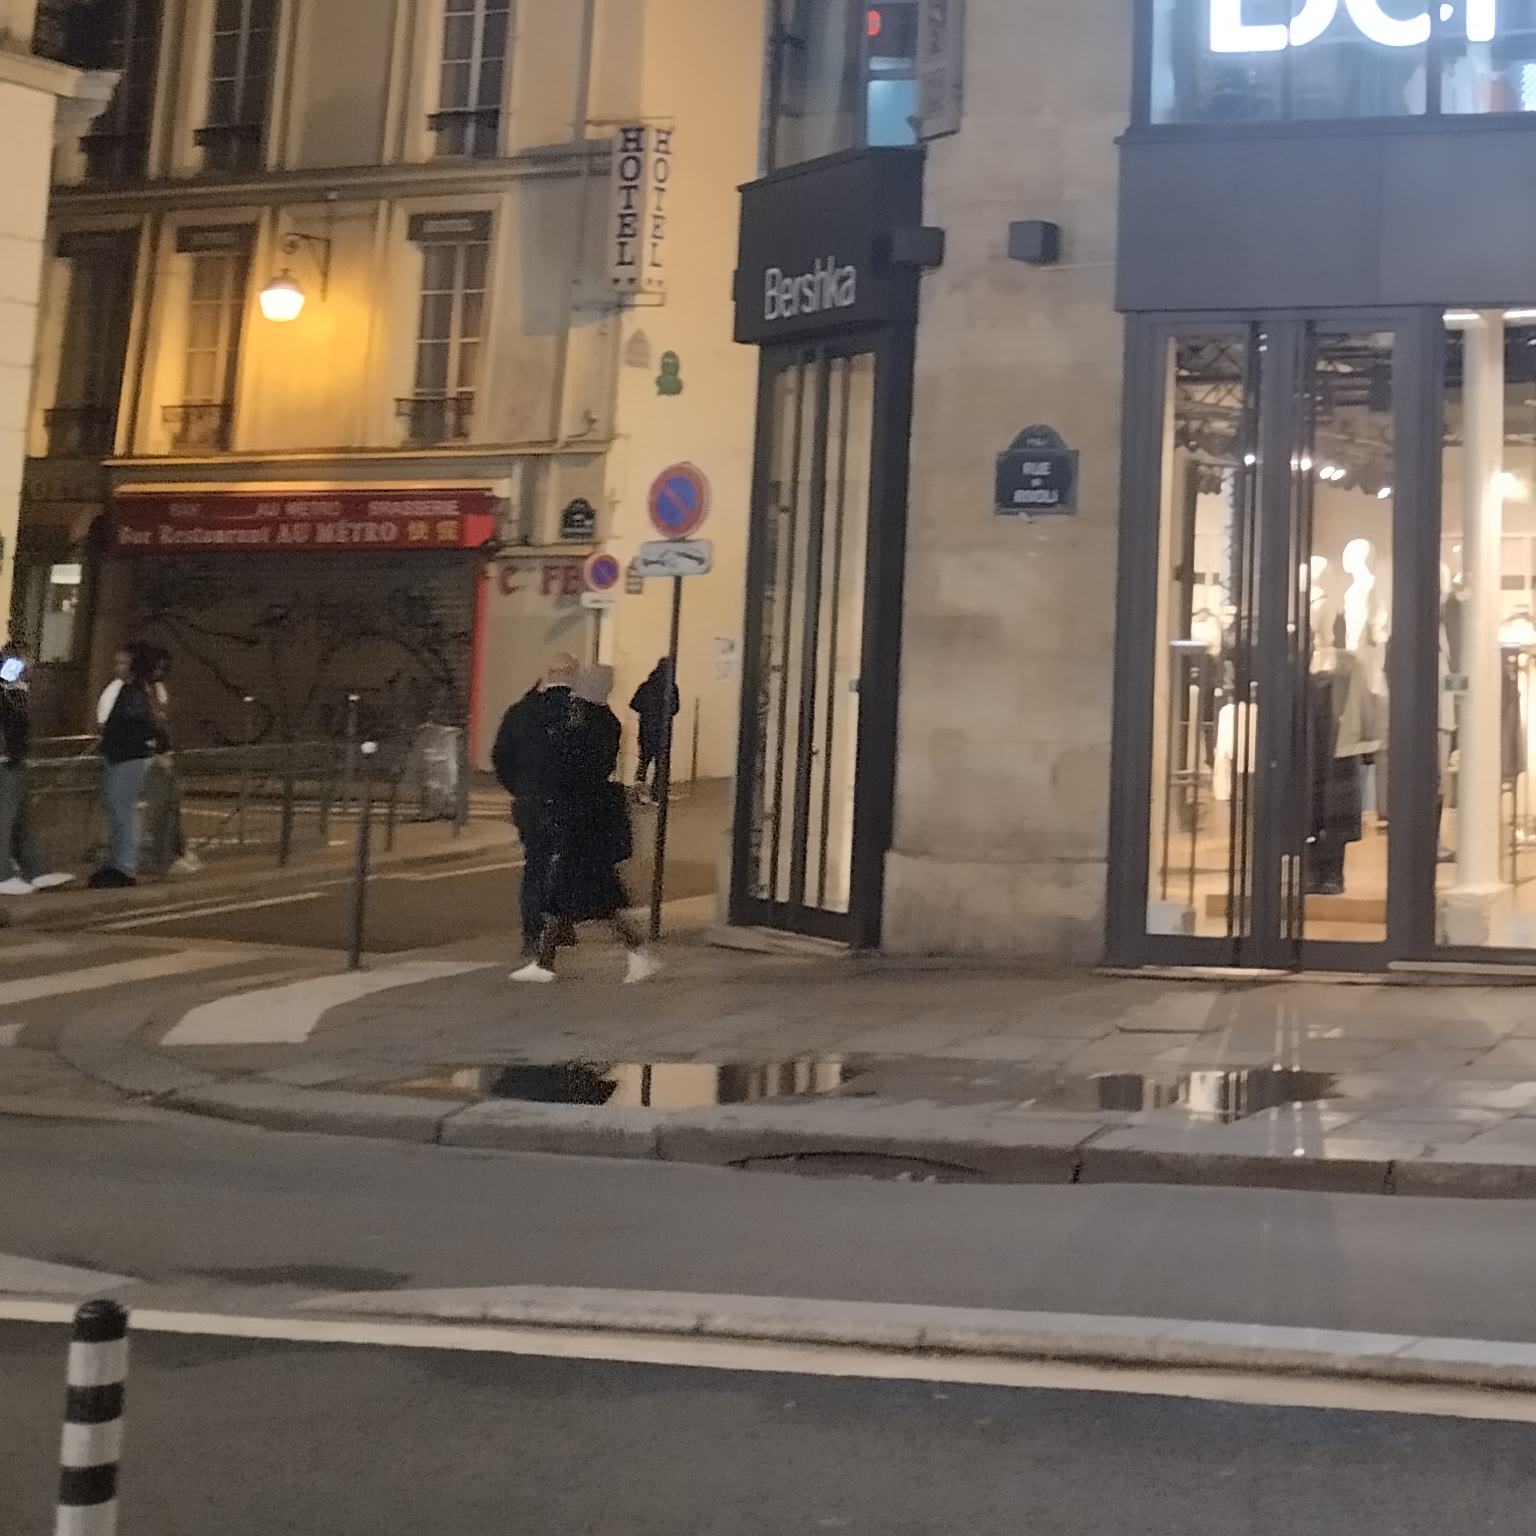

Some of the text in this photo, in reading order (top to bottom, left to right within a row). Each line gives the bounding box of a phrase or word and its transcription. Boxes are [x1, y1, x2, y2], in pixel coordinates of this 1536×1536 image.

[615, 127, 645, 267] HOTEL
[649, 128, 673, 268] HOTEL
[764, 255, 856, 320] Bershka
[275, 522, 312, 544] AU
